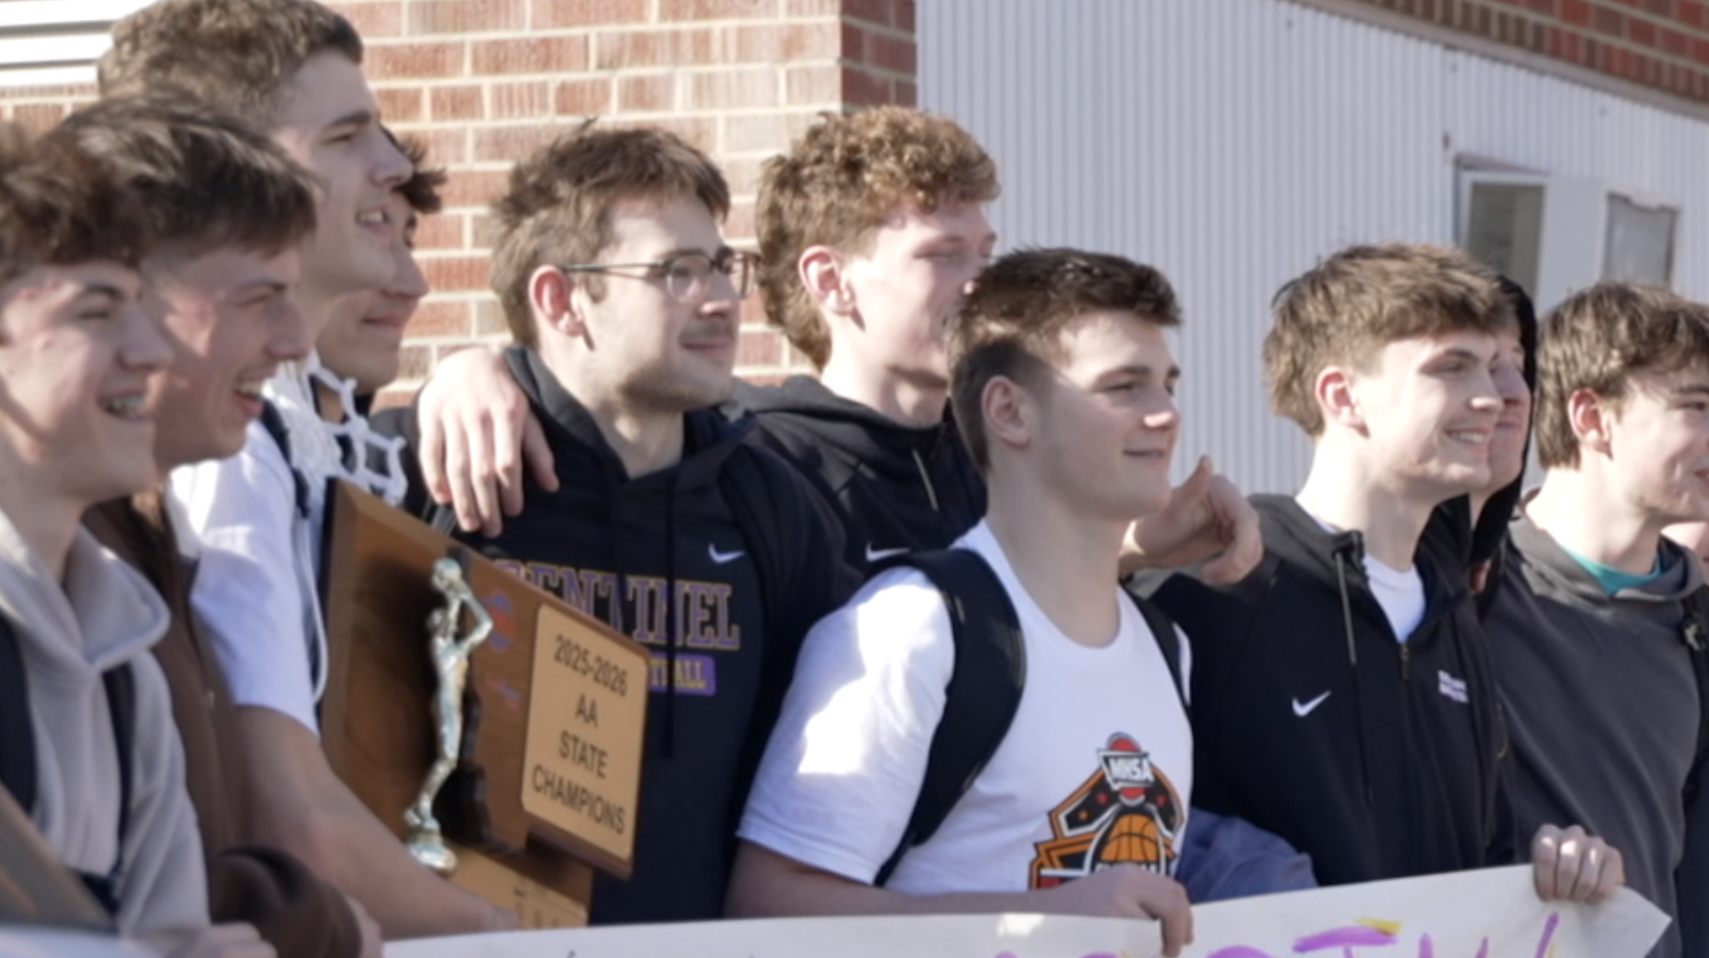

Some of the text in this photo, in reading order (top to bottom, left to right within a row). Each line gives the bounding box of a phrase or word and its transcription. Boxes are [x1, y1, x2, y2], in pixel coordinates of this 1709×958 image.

[553, 634, 628, 697] 2025-2026
[574, 693, 598, 729] AA
[559, 730, 607, 780] STATE
[532, 764, 626, 836] CHAMPIONS
